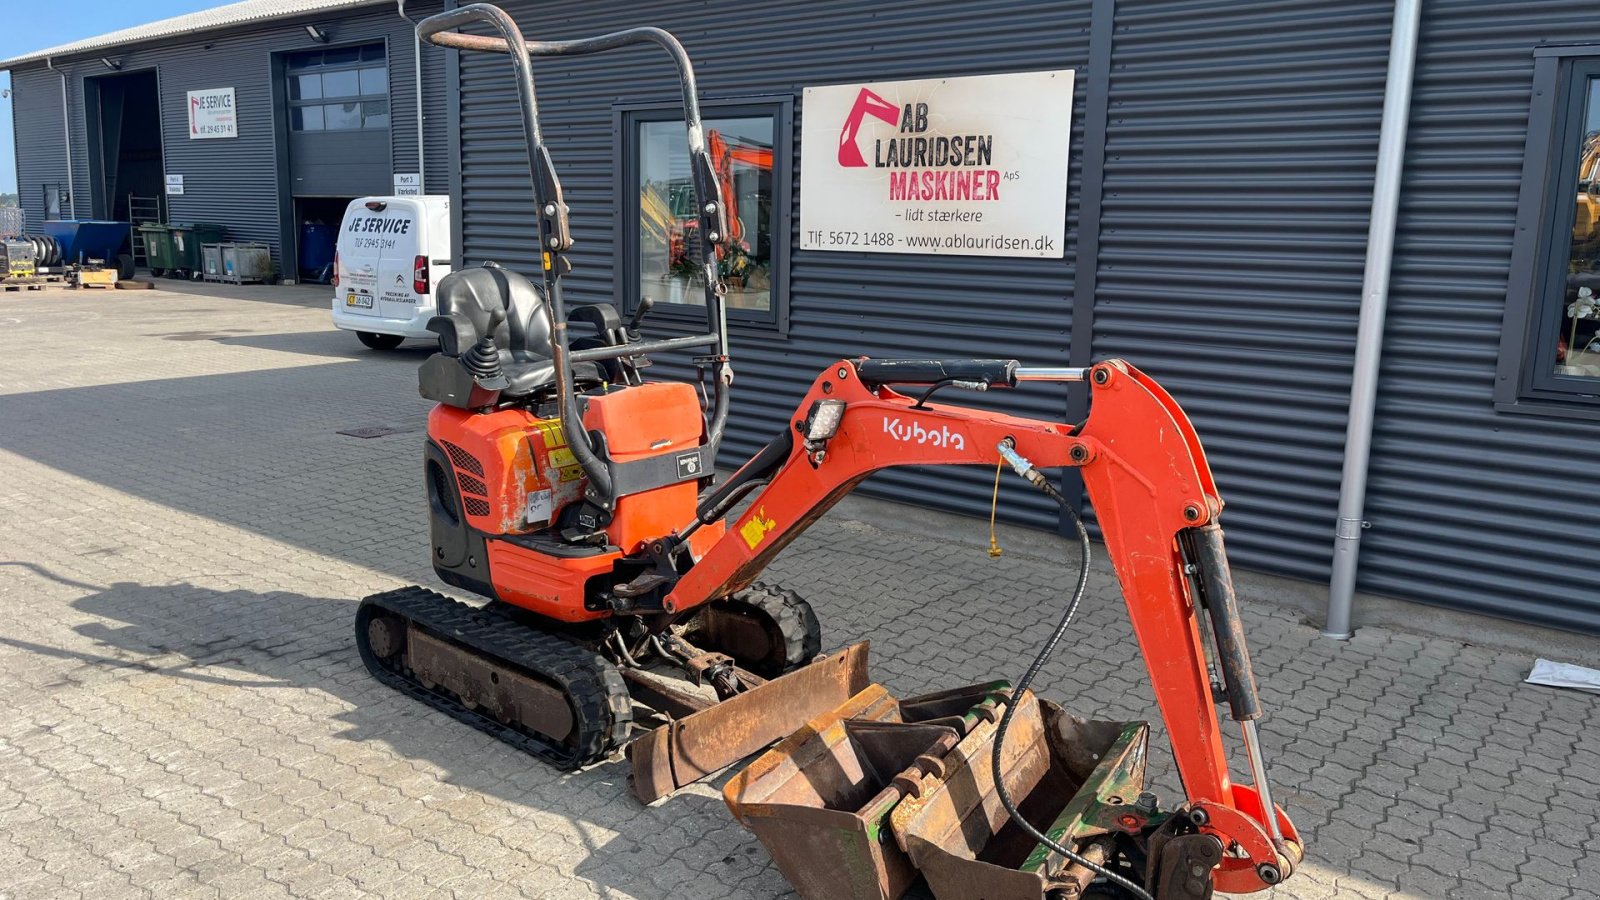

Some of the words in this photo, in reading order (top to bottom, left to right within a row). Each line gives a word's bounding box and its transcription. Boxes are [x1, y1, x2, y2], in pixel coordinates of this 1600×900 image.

[199, 97, 205, 109] JE
[206, 95, 231, 108] SERVICE
[900, 102, 929, 134] AB
[875, 134, 993, 168] LAURIDSEN
[889, 169, 1000, 201] MASKINER
[1003, 170, 1020, 181] ApS
[348, 217, 362, 233] JE
[362, 217, 411, 234] SERVICE
[904, 208, 924, 222] lidt
[927, 209, 983, 223] stærkere
[354, 238, 364, 248] TLF
[363, 238, 379, 248] 2945
[380, 239, 396, 249] 3141
[807, 230, 825, 246] Tlf.
[829, 231, 859, 246] 5672
[863, 232, 894, 247] 1488
[906, 233, 1054, 251] www.ablauridsen.dk
[883, 417, 964, 450] Kubota
